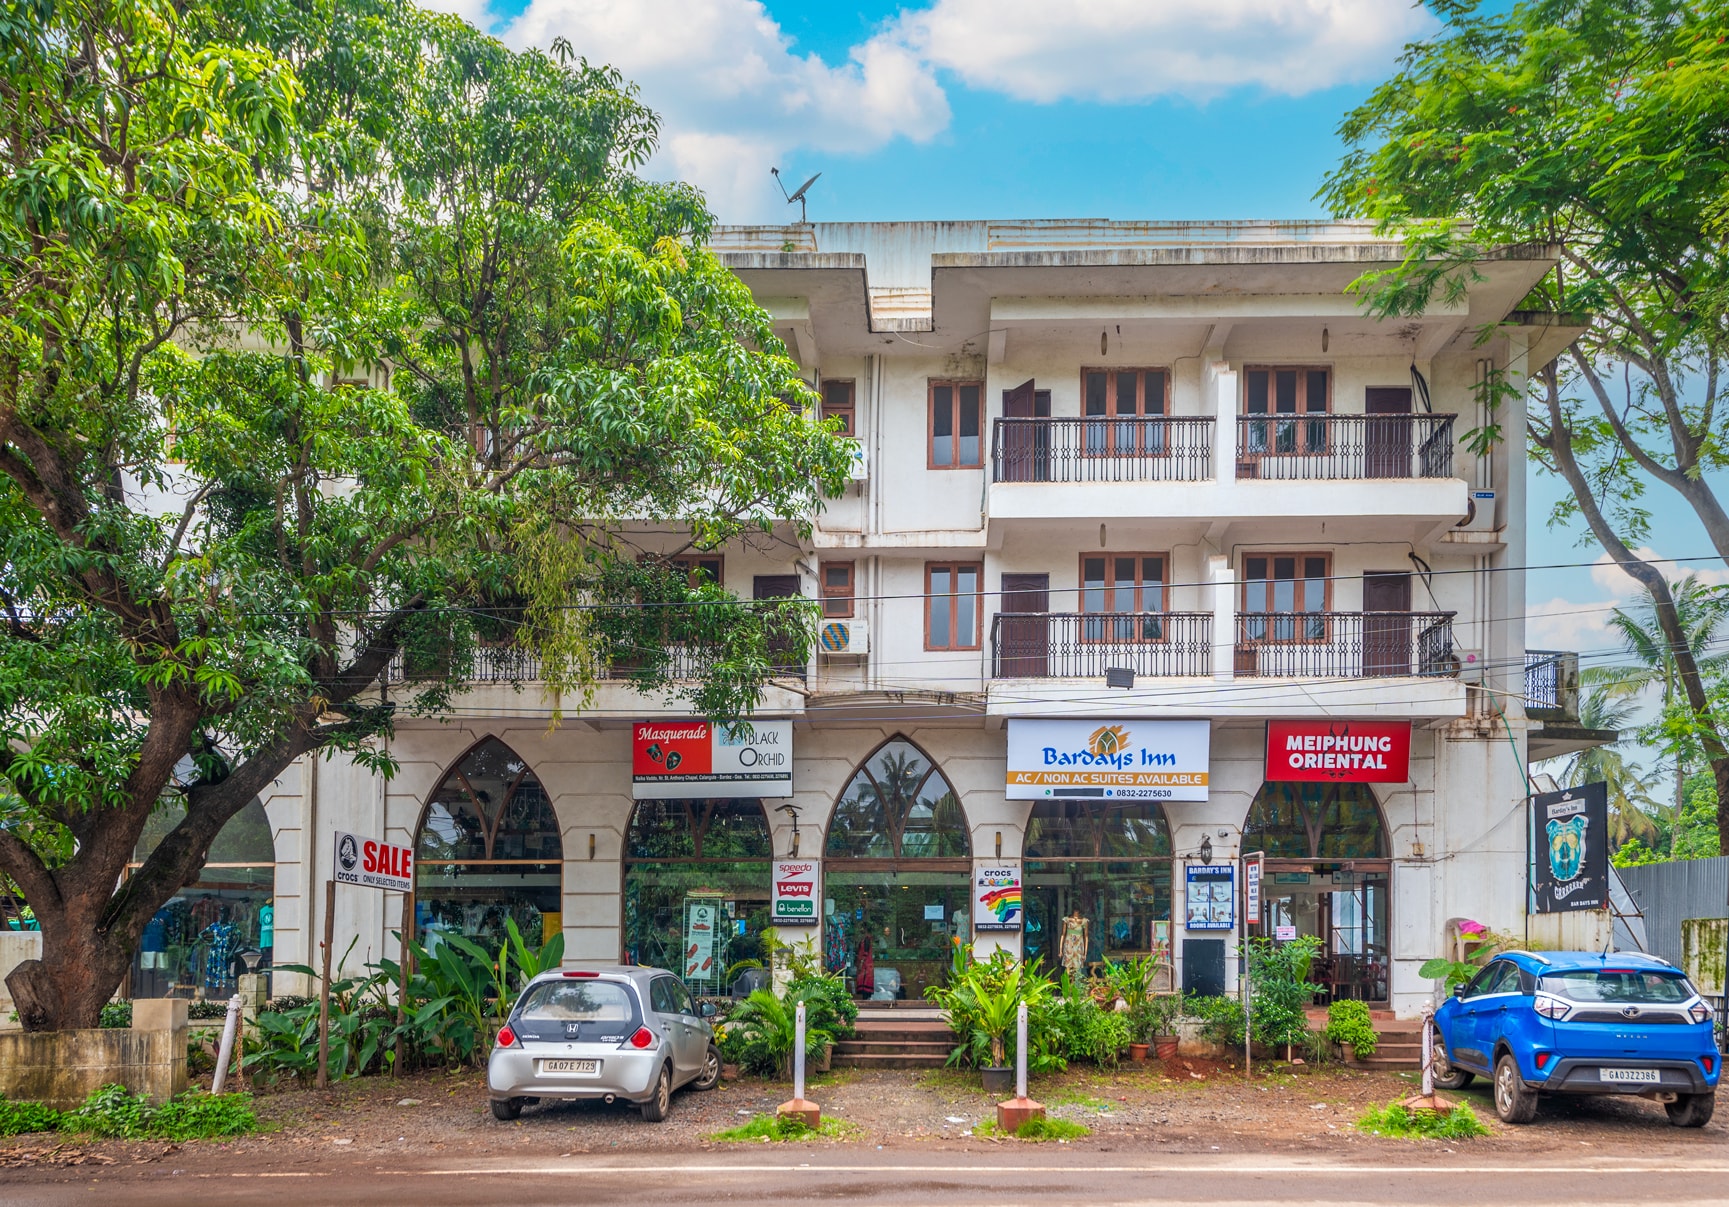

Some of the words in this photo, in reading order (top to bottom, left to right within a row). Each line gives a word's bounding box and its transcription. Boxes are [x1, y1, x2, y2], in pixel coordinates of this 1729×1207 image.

[638, 725, 706, 744] Masquerade
[1286, 736, 1391, 752] MEIPHUNG
[739, 748, 784, 766] ORCHID
[1042, 747, 1133, 770] Bardays
[1141, 748, 1176, 766] Inn
[1288, 753, 1388, 769] ORIENTAL
[1016, 773, 1032, 783] AC
[1034, 773, 1041, 784] /
[1044, 773, 1069, 784] NON
[1072, 774, 1088, 784] AC
[1091, 774, 1134, 784] SUITES
[1138, 774, 1202, 784] AVAILABLE
[1116, 790, 1172, 798] 0832-2275630
[363, 841, 412, 878] SALE
[779, 864, 812, 872] speedo
[338, 872, 358, 882] crocs
[363, 875, 375, 884] ONLY
[376, 877, 396, 887] SELECTED
[397, 881, 410, 890] ITEMS
[548, 1062, 558, 1070] GA
[560, 1062, 568, 1070] 07
[570, 1062, 574, 1070] E
[576, 1062, 595, 1070] 7129
